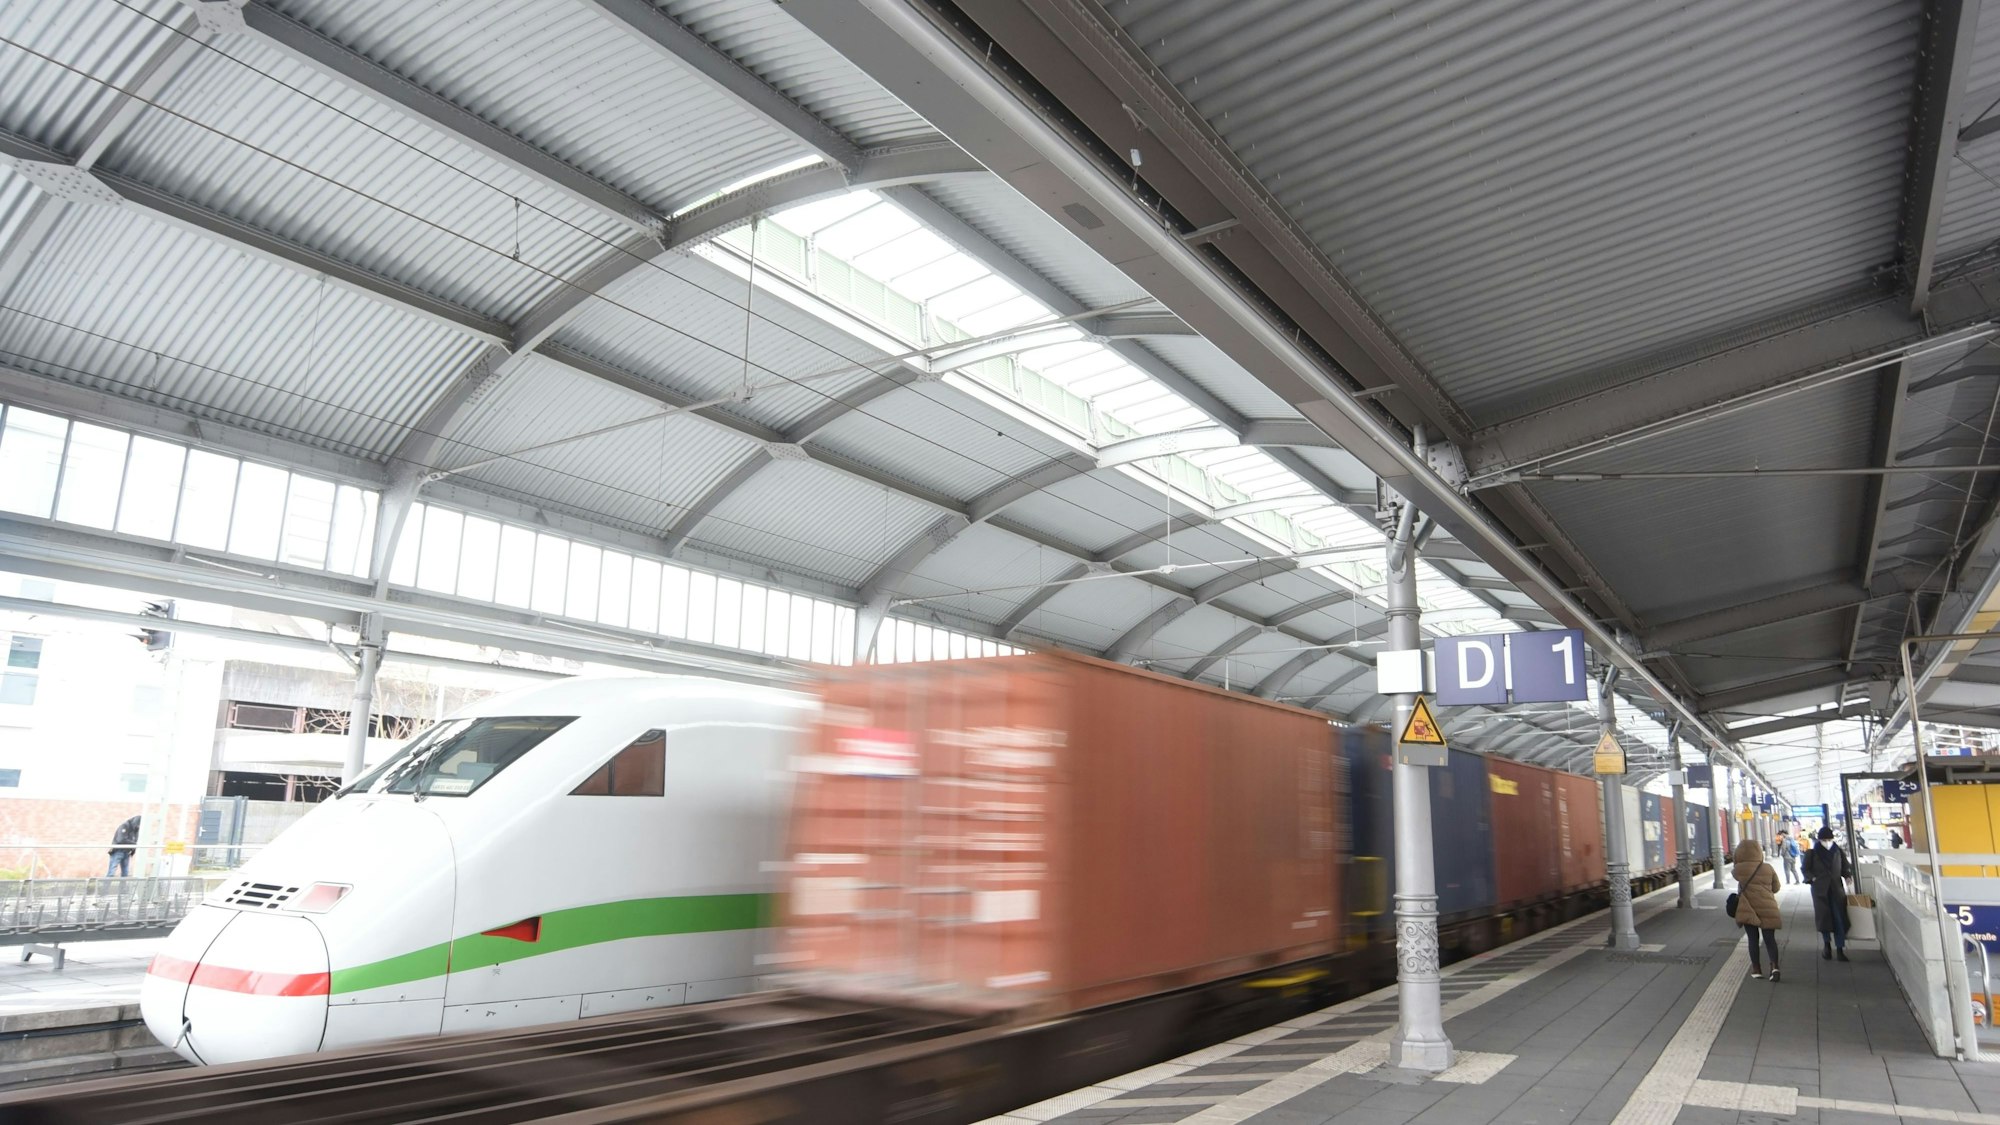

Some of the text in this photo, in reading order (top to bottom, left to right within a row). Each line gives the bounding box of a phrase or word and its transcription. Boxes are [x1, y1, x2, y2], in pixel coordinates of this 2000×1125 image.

[1457, 636, 1575, 689] D 1
[1898, 781, 1918, 791] 2-5
[1943, 905, 1974, 926] -5
